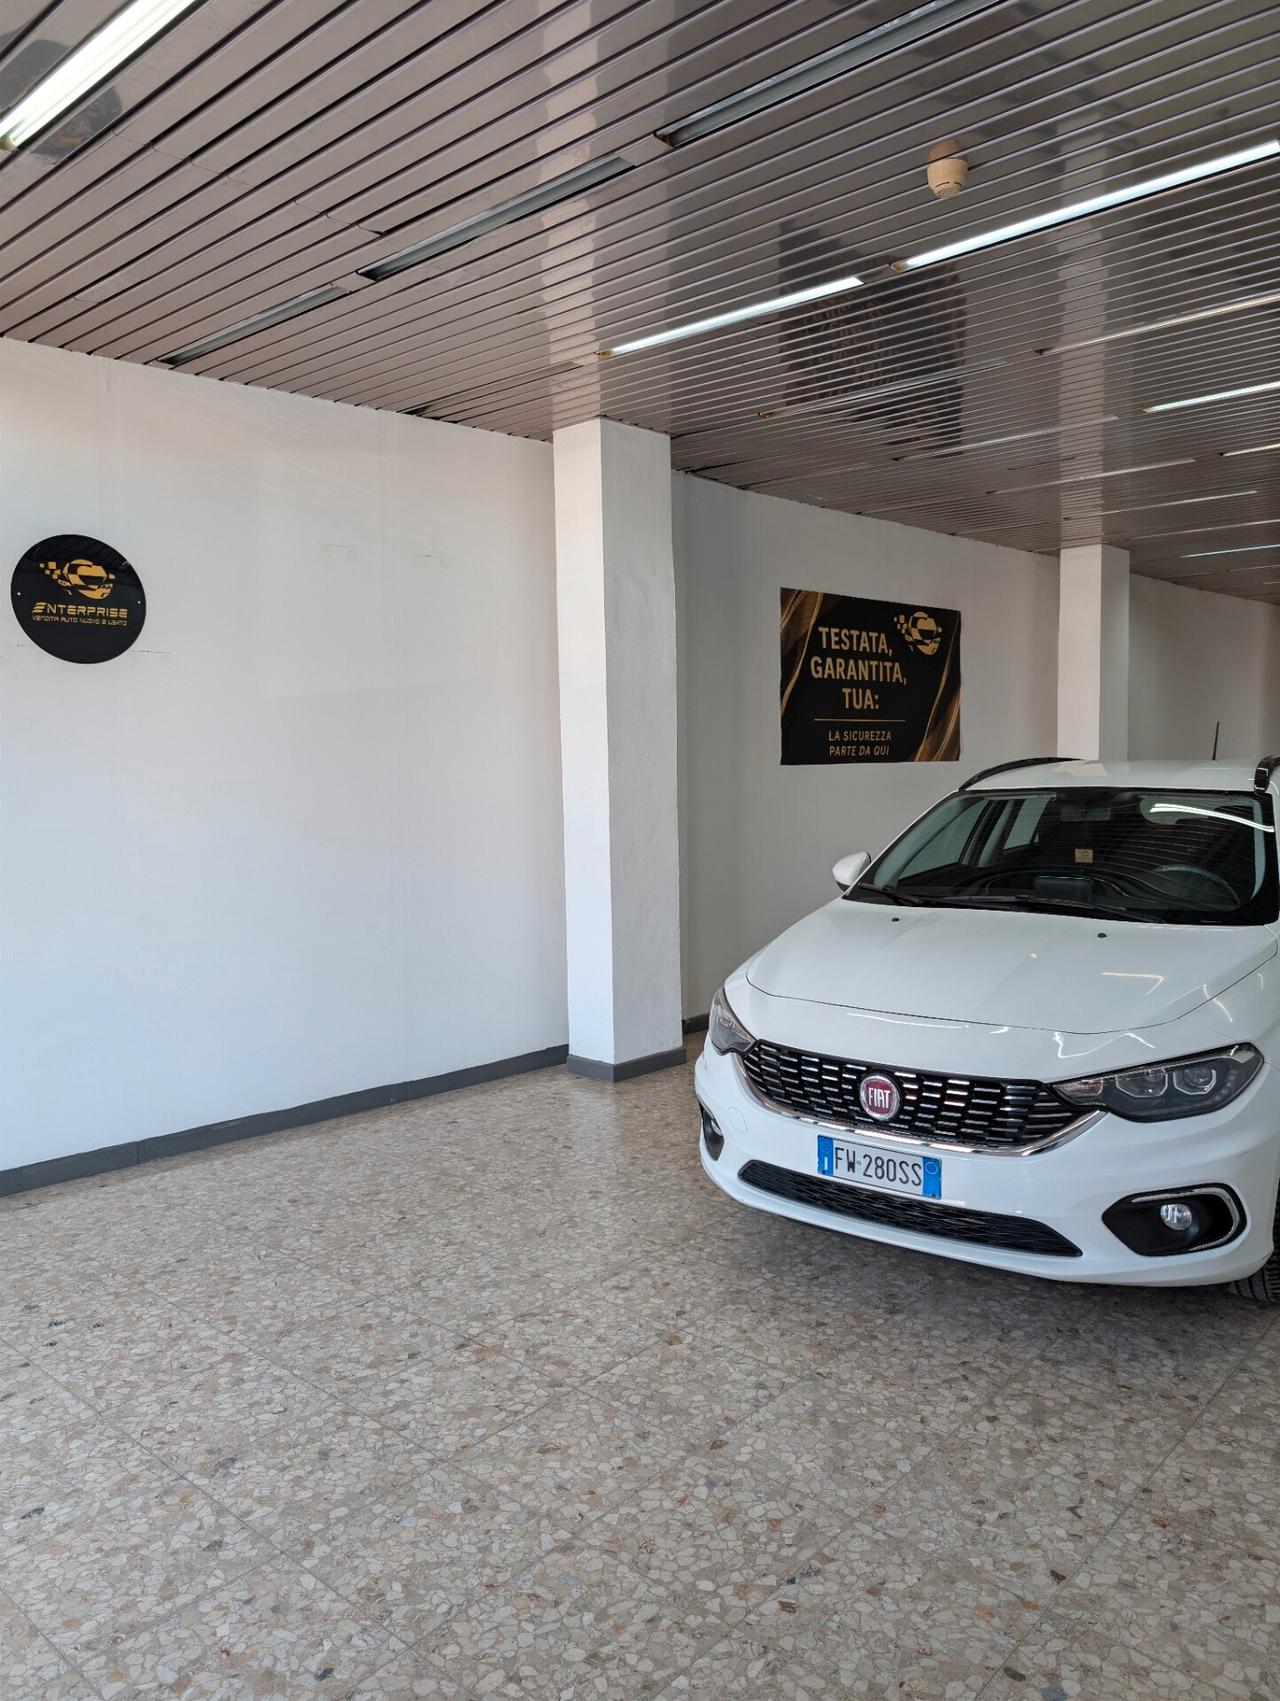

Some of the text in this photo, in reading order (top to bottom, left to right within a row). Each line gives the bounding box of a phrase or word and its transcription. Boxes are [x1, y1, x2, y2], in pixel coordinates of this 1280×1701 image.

[32, 602, 128, 617] ENTERPRISE
[818, 627, 893, 656] TESTATA,
[810, 656, 907, 685] GARANTITA,
[842, 688, 879, 709] TUA:
[829, 731, 892, 741] LA SICUREZZA
[830, 745, 890, 756] PARTE DA QUI
[868, 1088, 890, 1108] FIAT
[862, 1154, 922, 1186] 280SS
